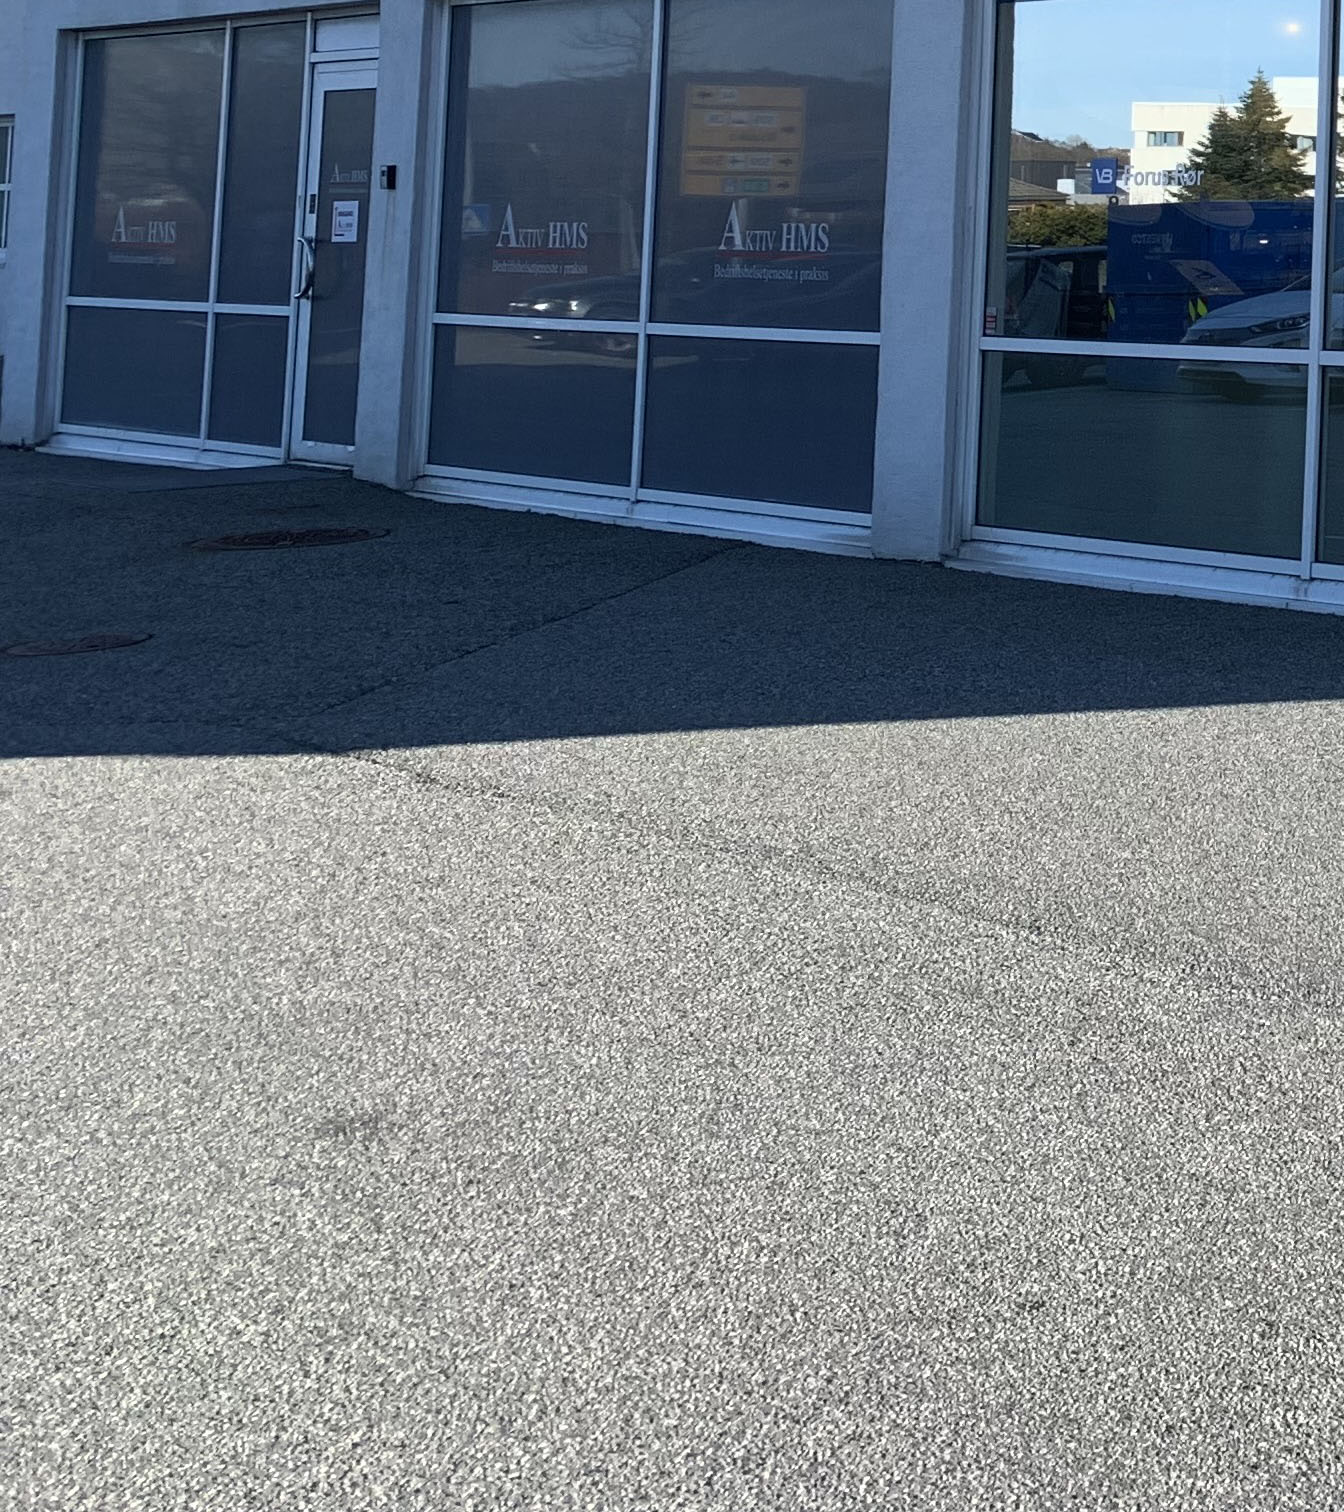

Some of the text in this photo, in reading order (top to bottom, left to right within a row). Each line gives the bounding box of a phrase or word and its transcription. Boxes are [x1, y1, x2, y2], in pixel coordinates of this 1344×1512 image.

[1095, 168, 1113, 184] VB
[1122, 163, 1204, 186] Forus Rør
[548, 222, 588, 248] HMS
[780, 222, 830, 252] HMS
